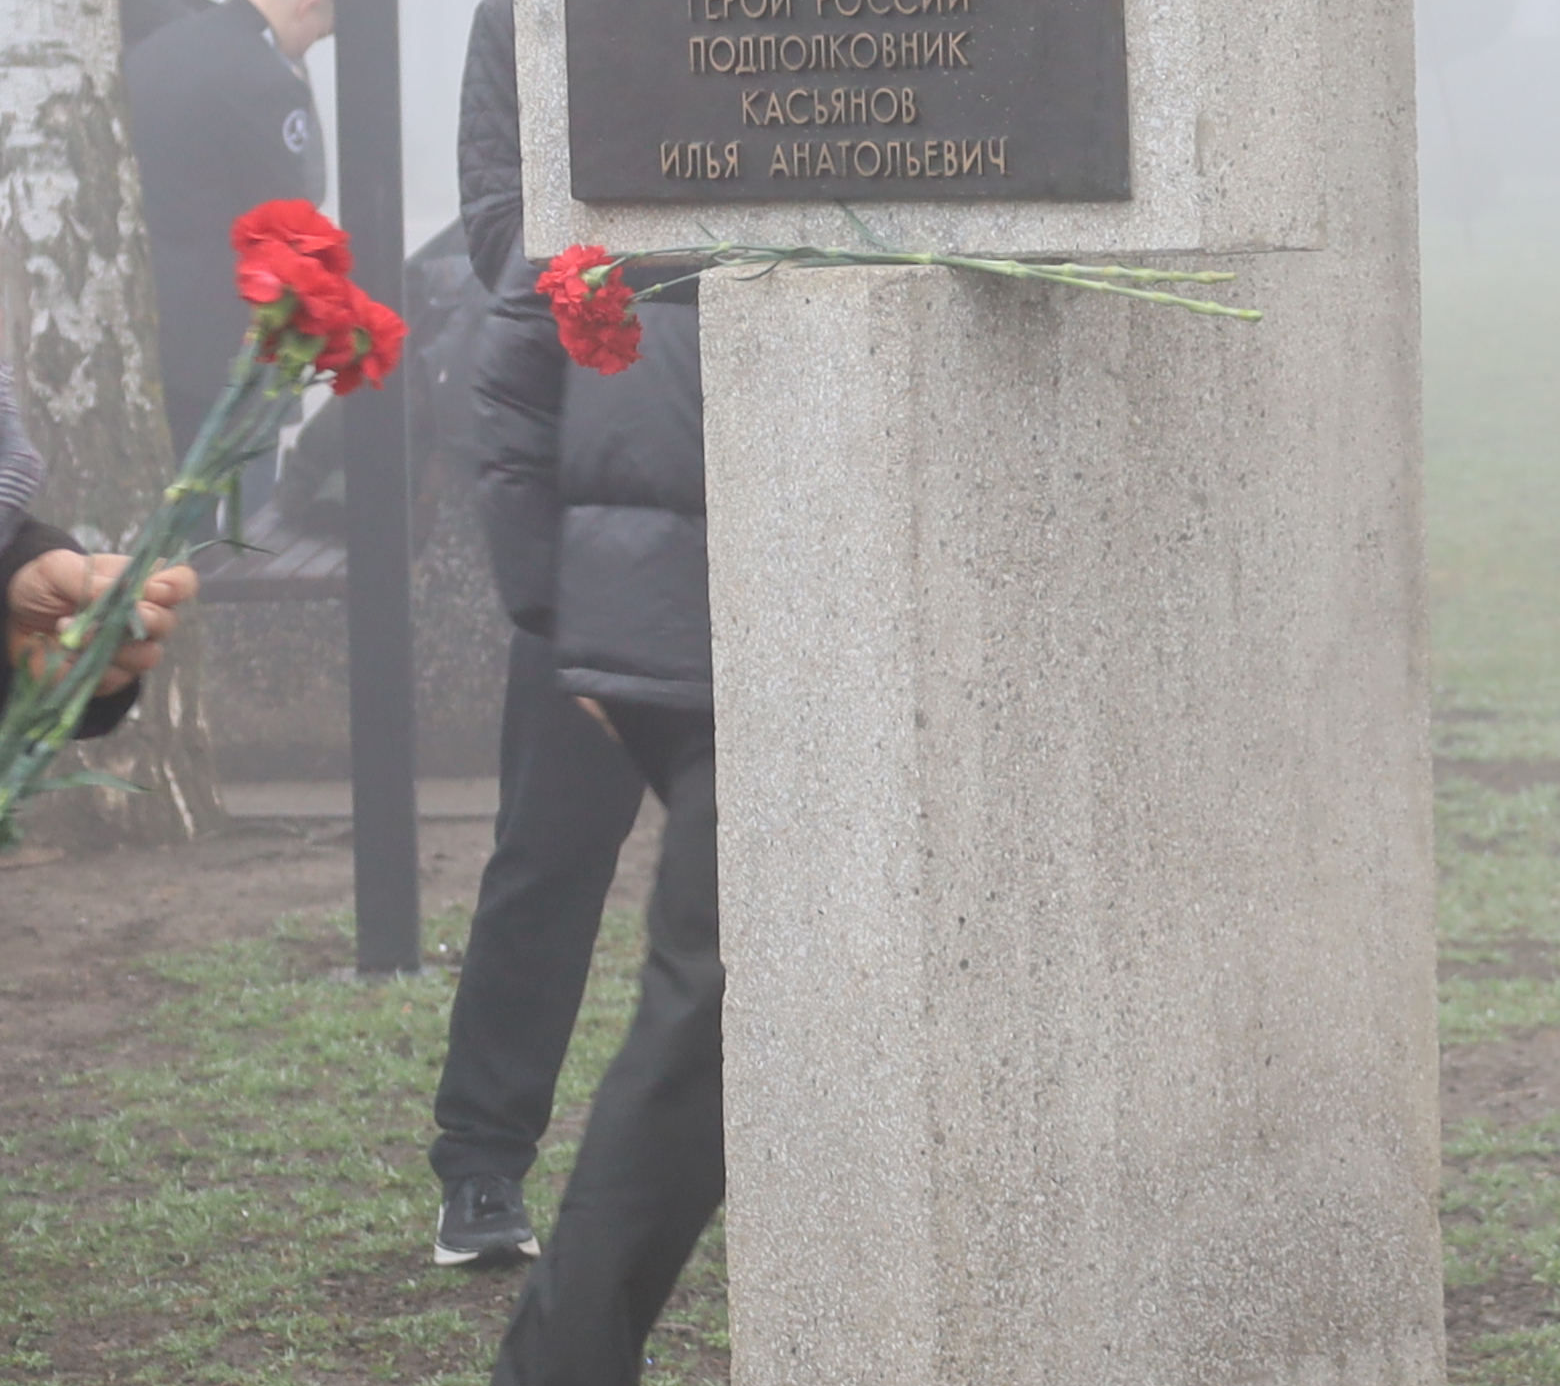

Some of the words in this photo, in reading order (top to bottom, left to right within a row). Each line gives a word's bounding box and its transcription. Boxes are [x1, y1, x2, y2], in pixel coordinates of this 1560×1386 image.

[689, 31, 968, 75] ПОДПОЛКОВНИК
[741, 87, 917, 126] КАСЬЯНОВ
[660, 141, 739, 179] ИЛЬЯ
[769, 138, 1007, 177] АНАТОЛЬЕВИЧ
